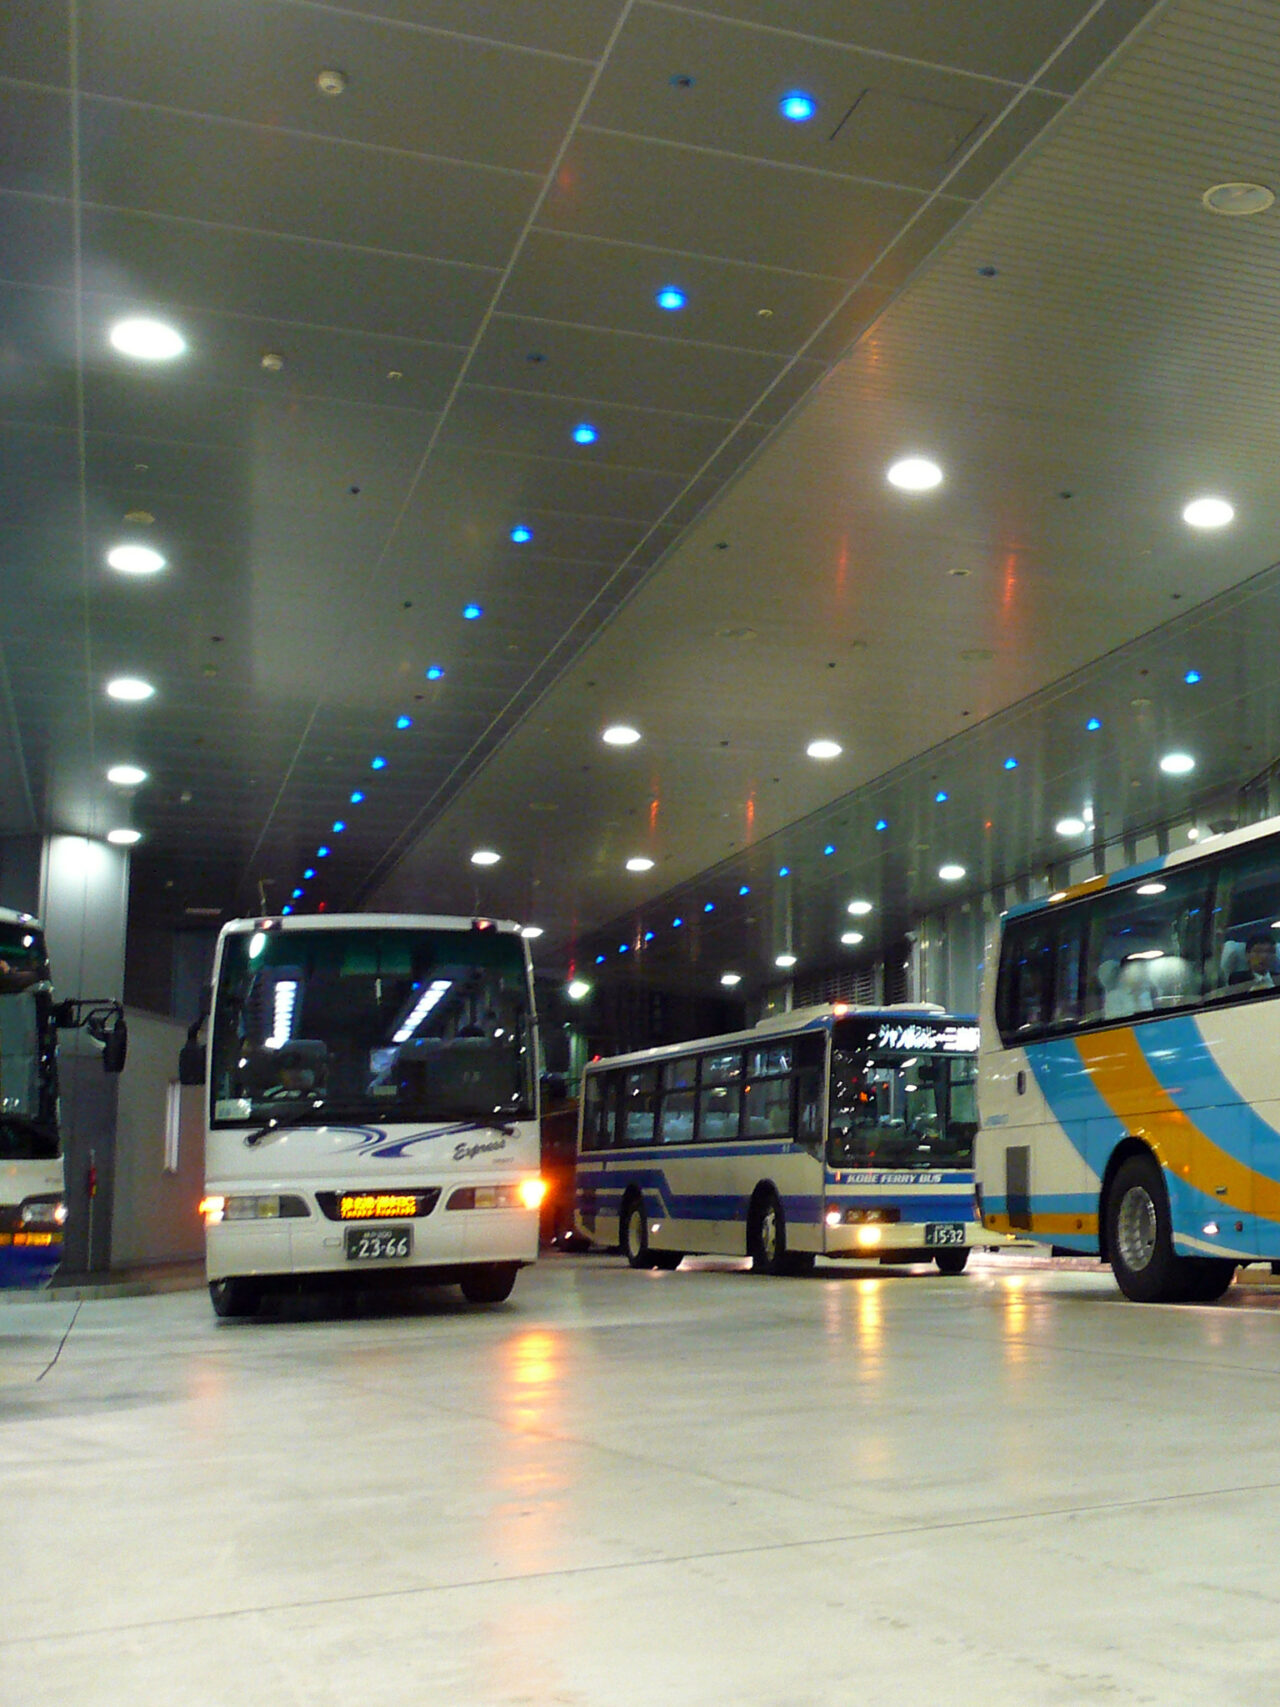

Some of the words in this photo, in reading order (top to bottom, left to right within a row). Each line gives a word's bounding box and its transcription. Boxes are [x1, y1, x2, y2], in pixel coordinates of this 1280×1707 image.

[453, 1139, 506, 1160] Express
[846, 1173, 879, 1183] KOBE
[880, 1173, 917, 1183] FERRY
[919, 1173, 942, 1183] BUS
